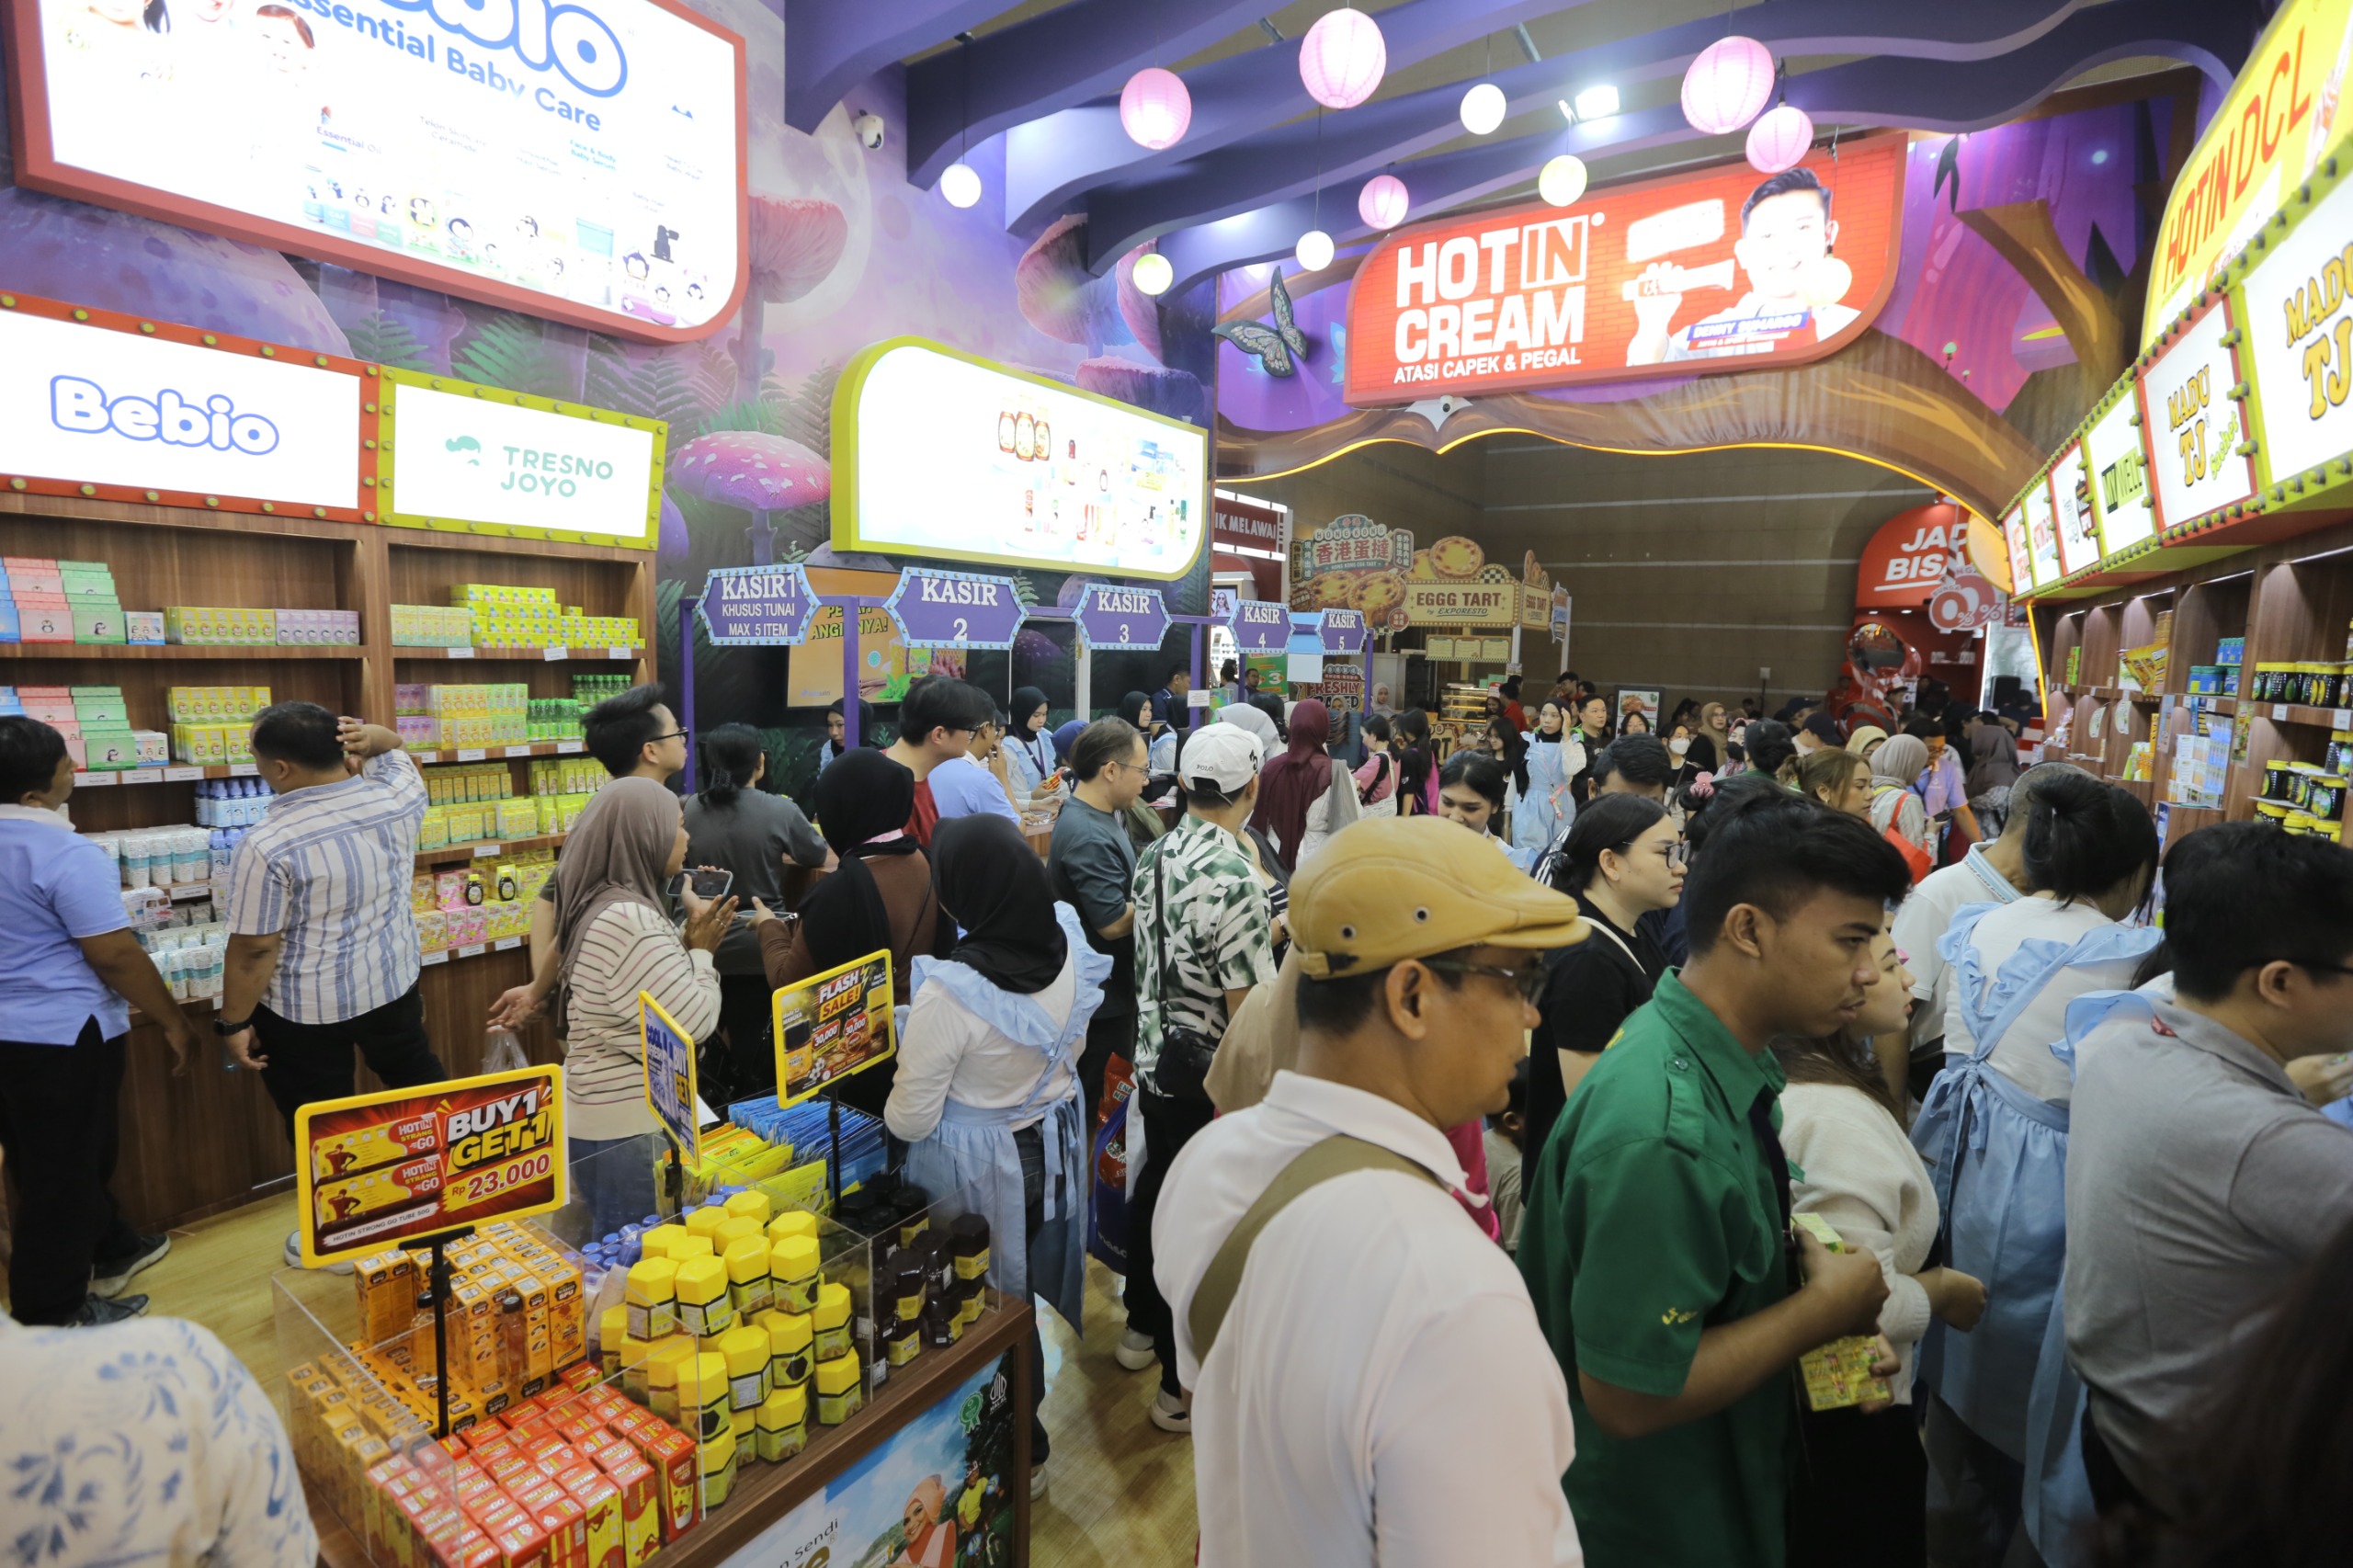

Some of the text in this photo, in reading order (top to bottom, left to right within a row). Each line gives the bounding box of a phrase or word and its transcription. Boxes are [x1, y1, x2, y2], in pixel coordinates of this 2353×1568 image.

[285, 0, 602, 131] ssential Baby Care
[2234, 23, 2311, 203] DCL
[316, 126, 364, 150] Essential
[570, 139, 587, 153] Face
[1393, 286, 1585, 362] CREAM
[1692, 322, 1737, 339] DENNY
[1393, 347, 1582, 383] ATASI CAPEK & PEGAL
[2302, 316, 2353, 421] TJ
[2167, 364, 2211, 432] MADU
[50, 373, 279, 456] Bebio
[502, 445, 614, 481] TRESNO
[2179, 418, 2206, 487] TJ
[500, 469, 577, 498] JOYO
[1228, 515, 1277, 540] MELAWAI
[1314, 525, 1386, 540] HONG KONG
[921, 577, 998, 607] KASIR
[1097, 590, 1151, 614] KASIR
[1416, 592, 1501, 607] EGGG TART
[722, 602, 795, 617] KHUSUS TUNAI
[1245, 606, 1281, 625] KASIR
[1328, 613, 1357, 630] KASIR
[1438, 607, 1489, 616] EXPORESTO
[729, 623, 788, 637] MAX 5 ITEM
[953, 619, 968, 642] 2
[1120, 623, 1130, 644] 3
[1258, 632, 1267, 649] 4
[1338, 635, 1345, 650] 5
[1306, 681, 1360, 696] FRESHLY
[1197, 764, 1214, 772] POLO
[819, 970, 859, 1005] FLASH
[823, 986, 860, 1018] SALE!
[1118, 1082, 1133, 1094] ENA
[417, 1135, 436, 1149] GO
[420, 1177, 439, 1191] GO
[452, 1153, 550, 1201] Rp 23.000
[333, 1231, 356, 1242] HOTIN
[358, 1221, 386, 1234] STRONG
[399, 1212, 415, 1221] TUBE
[795, 1517, 838, 1561] Sendi
